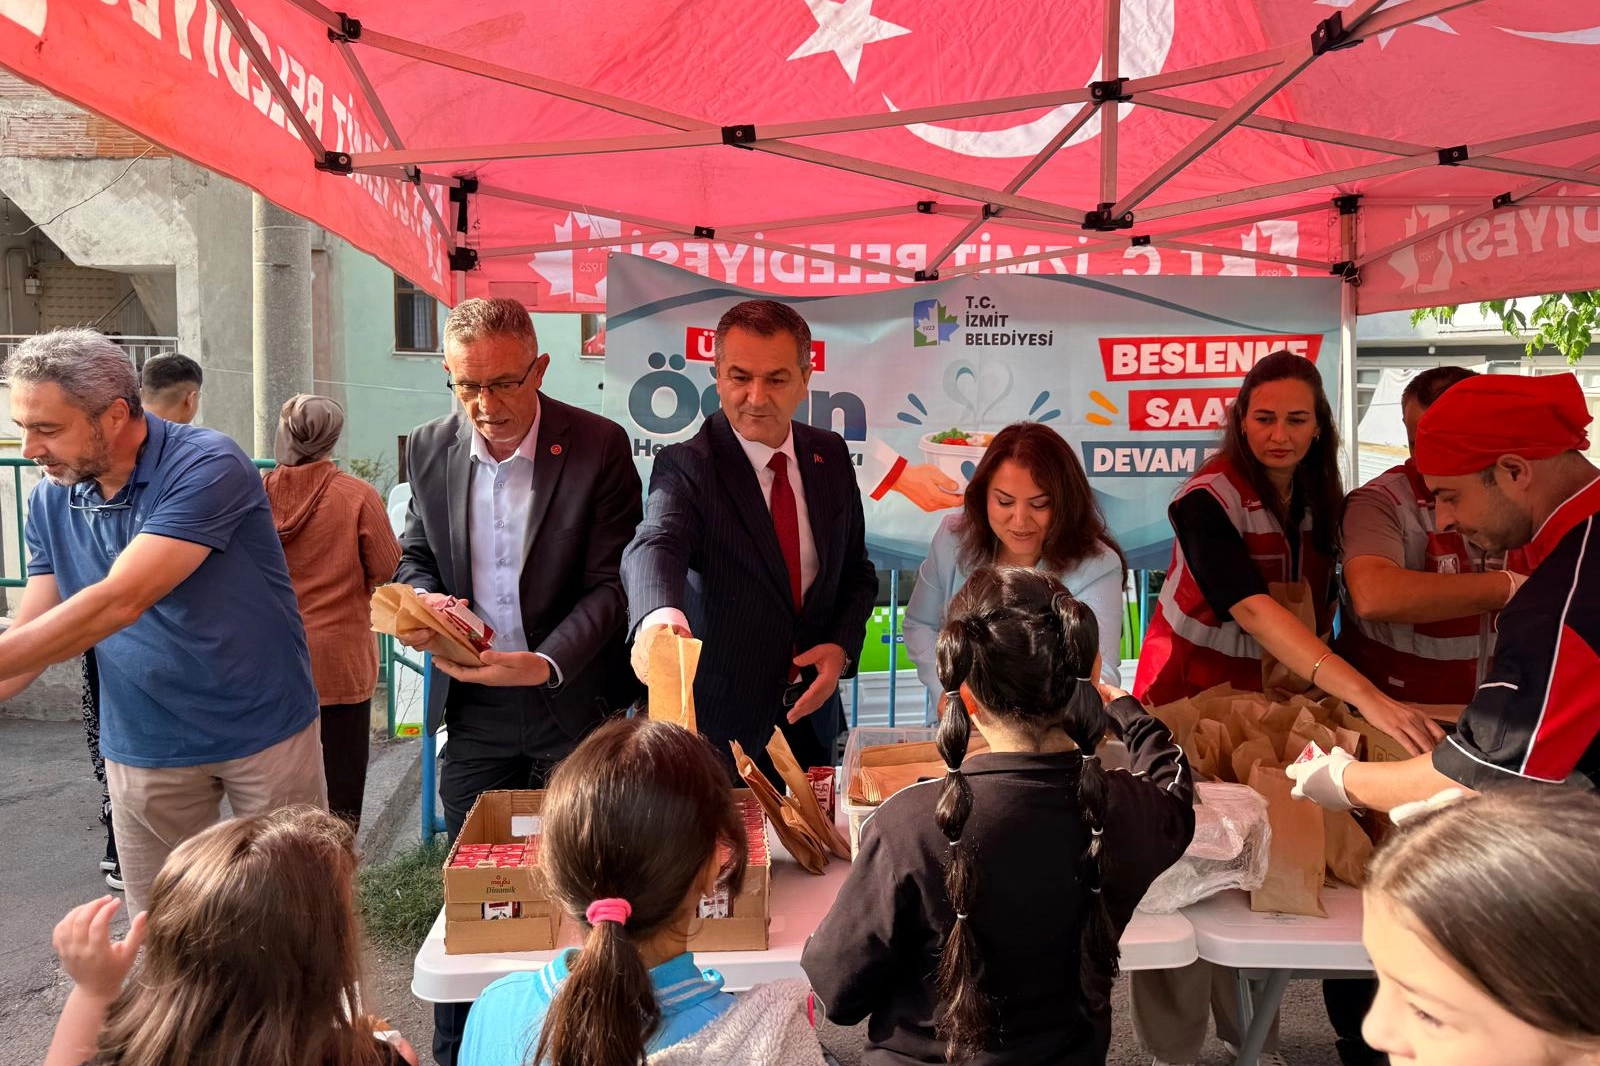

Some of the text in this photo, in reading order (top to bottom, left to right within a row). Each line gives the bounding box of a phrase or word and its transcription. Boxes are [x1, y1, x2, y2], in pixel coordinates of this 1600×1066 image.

[965, 296, 996, 309] T.C.
[965, 311, 1009, 328] İZMİT
[965, 329, 1053, 346] BELEDİYESİ
[1093, 447, 1197, 473] DEVAM
